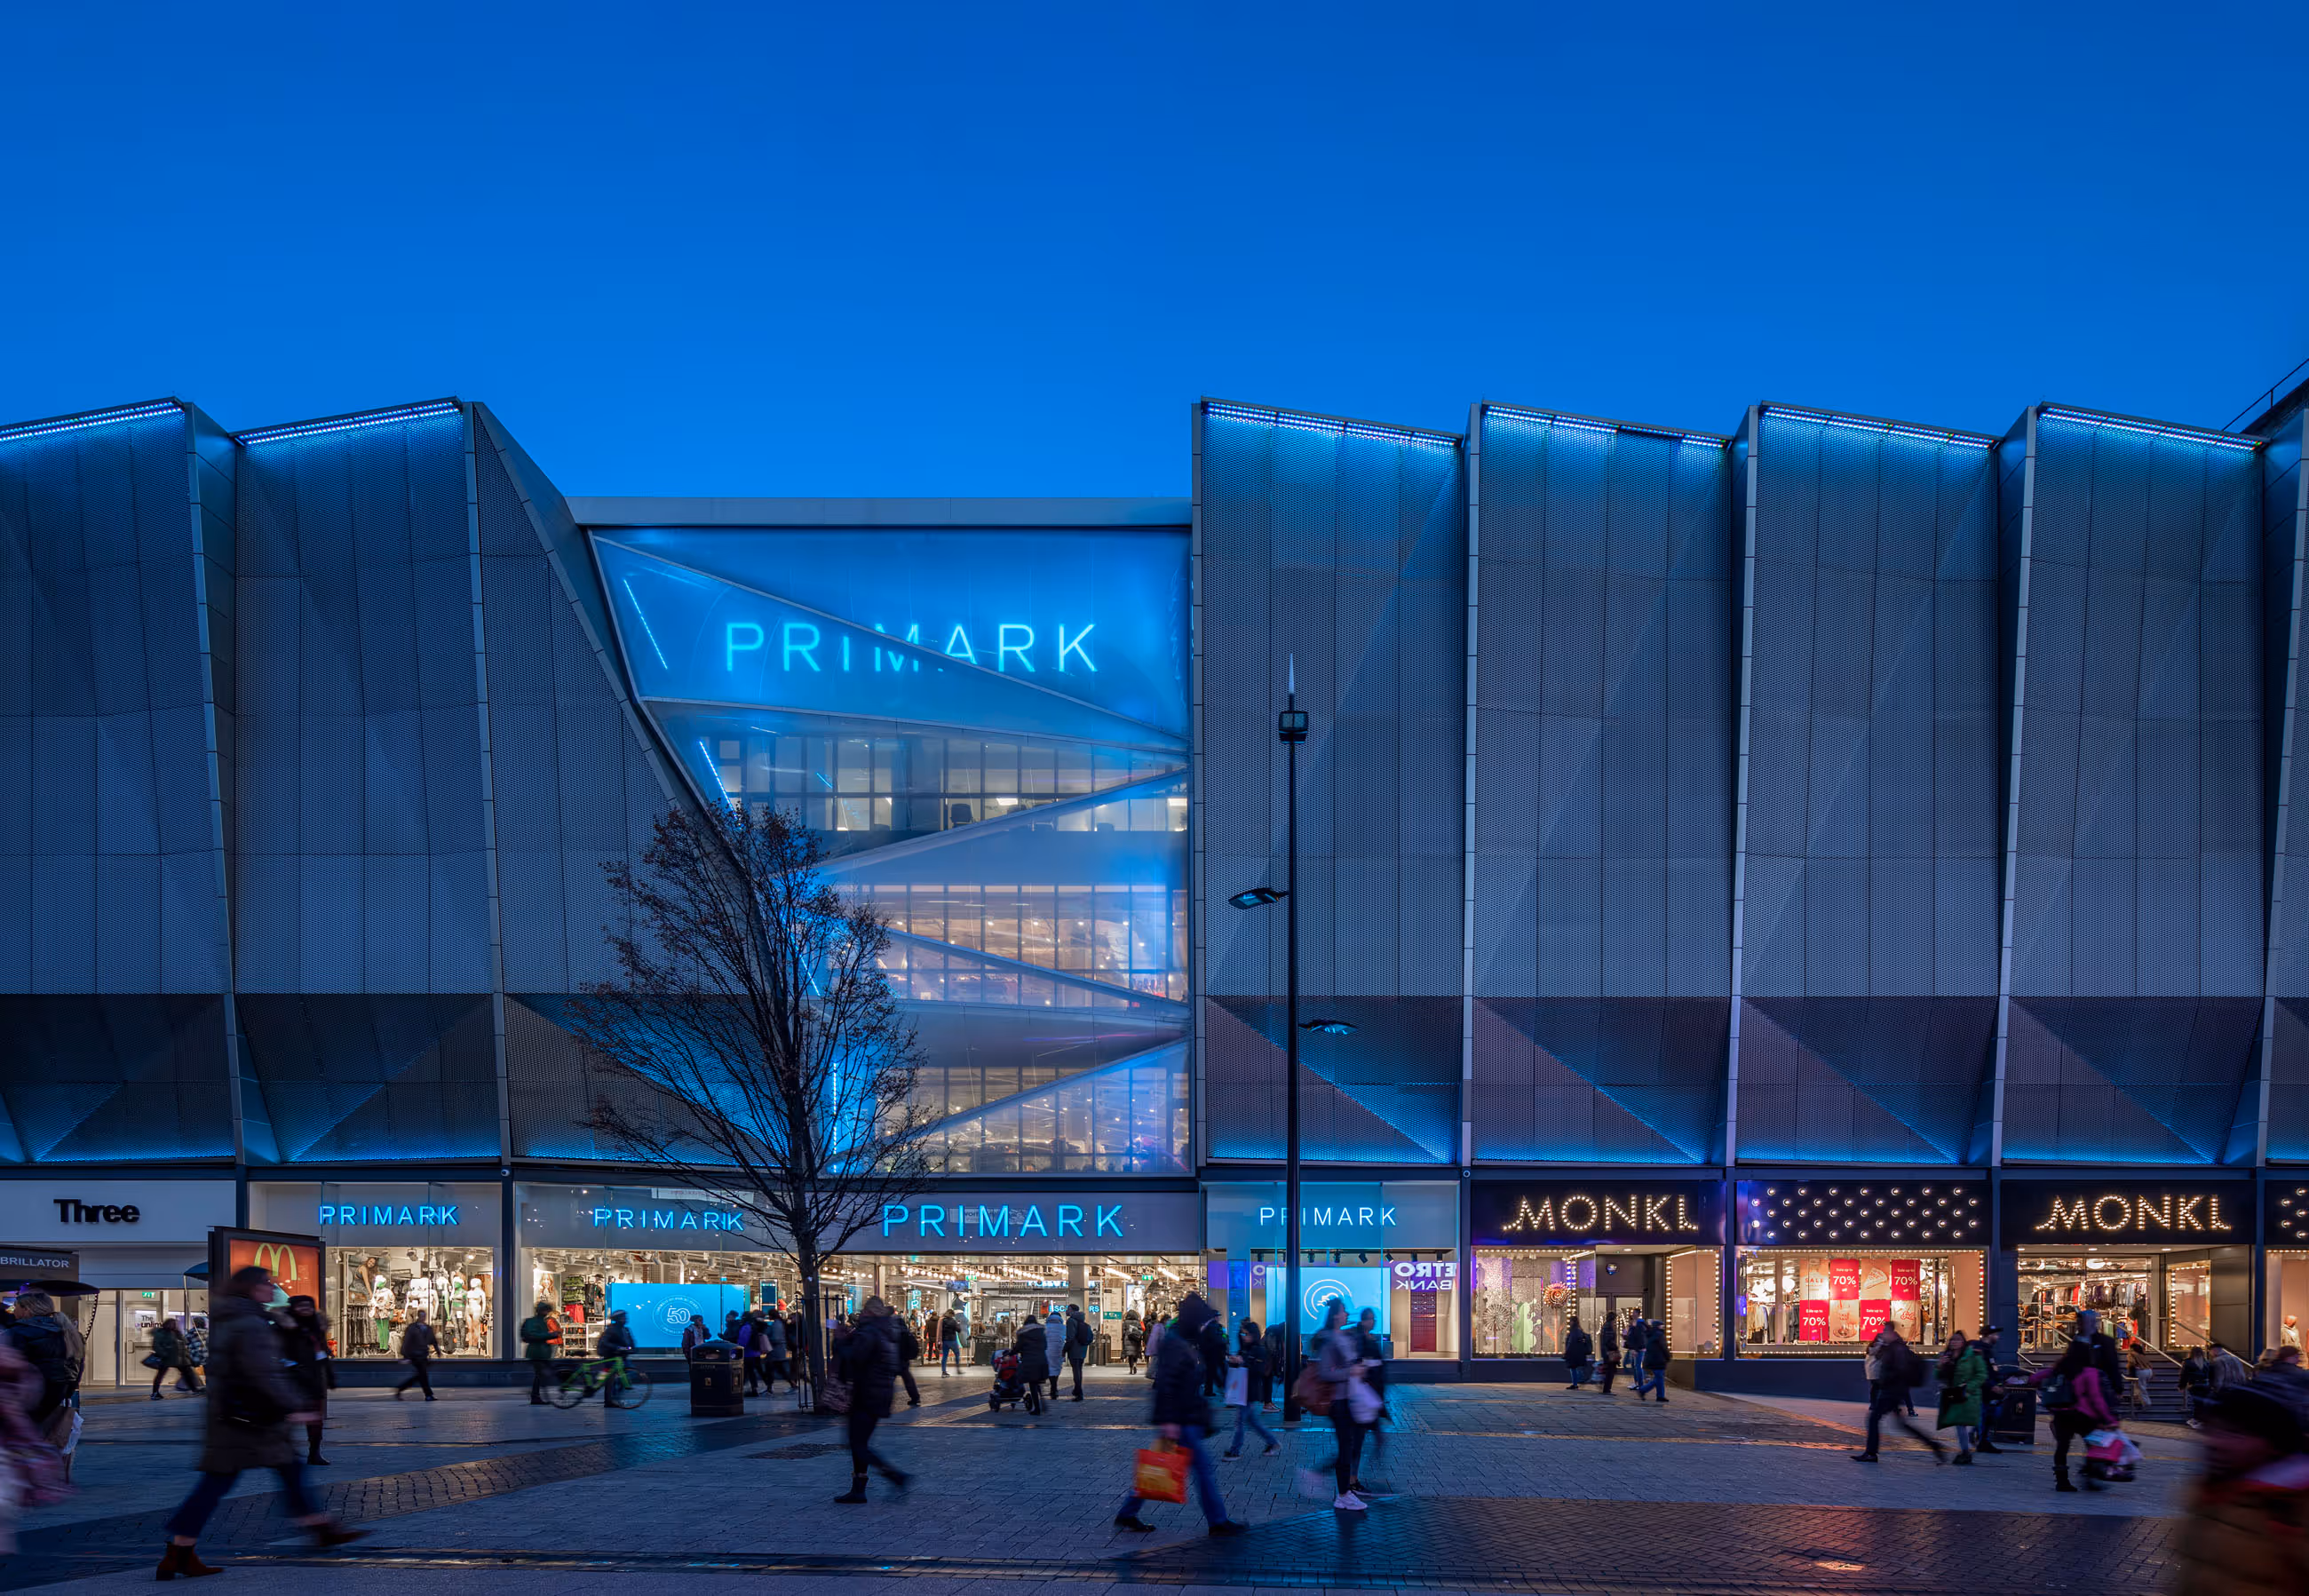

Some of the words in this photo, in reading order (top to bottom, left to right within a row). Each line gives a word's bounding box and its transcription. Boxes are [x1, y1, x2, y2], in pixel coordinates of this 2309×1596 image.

[725, 623, 1099, 672] PRIMARK
[53, 1199, 140, 1223] Three
[320, 1205, 460, 1226] PRIMARK
[593, 1208, 745, 1231] PRIMARK
[882, 1204, 1124, 1237] PRIMARK
[1894, 1276, 1918, 1285] 70%
[667, 1307, 690, 1323] 50
[1803, 1317, 1826, 1326] 70%
